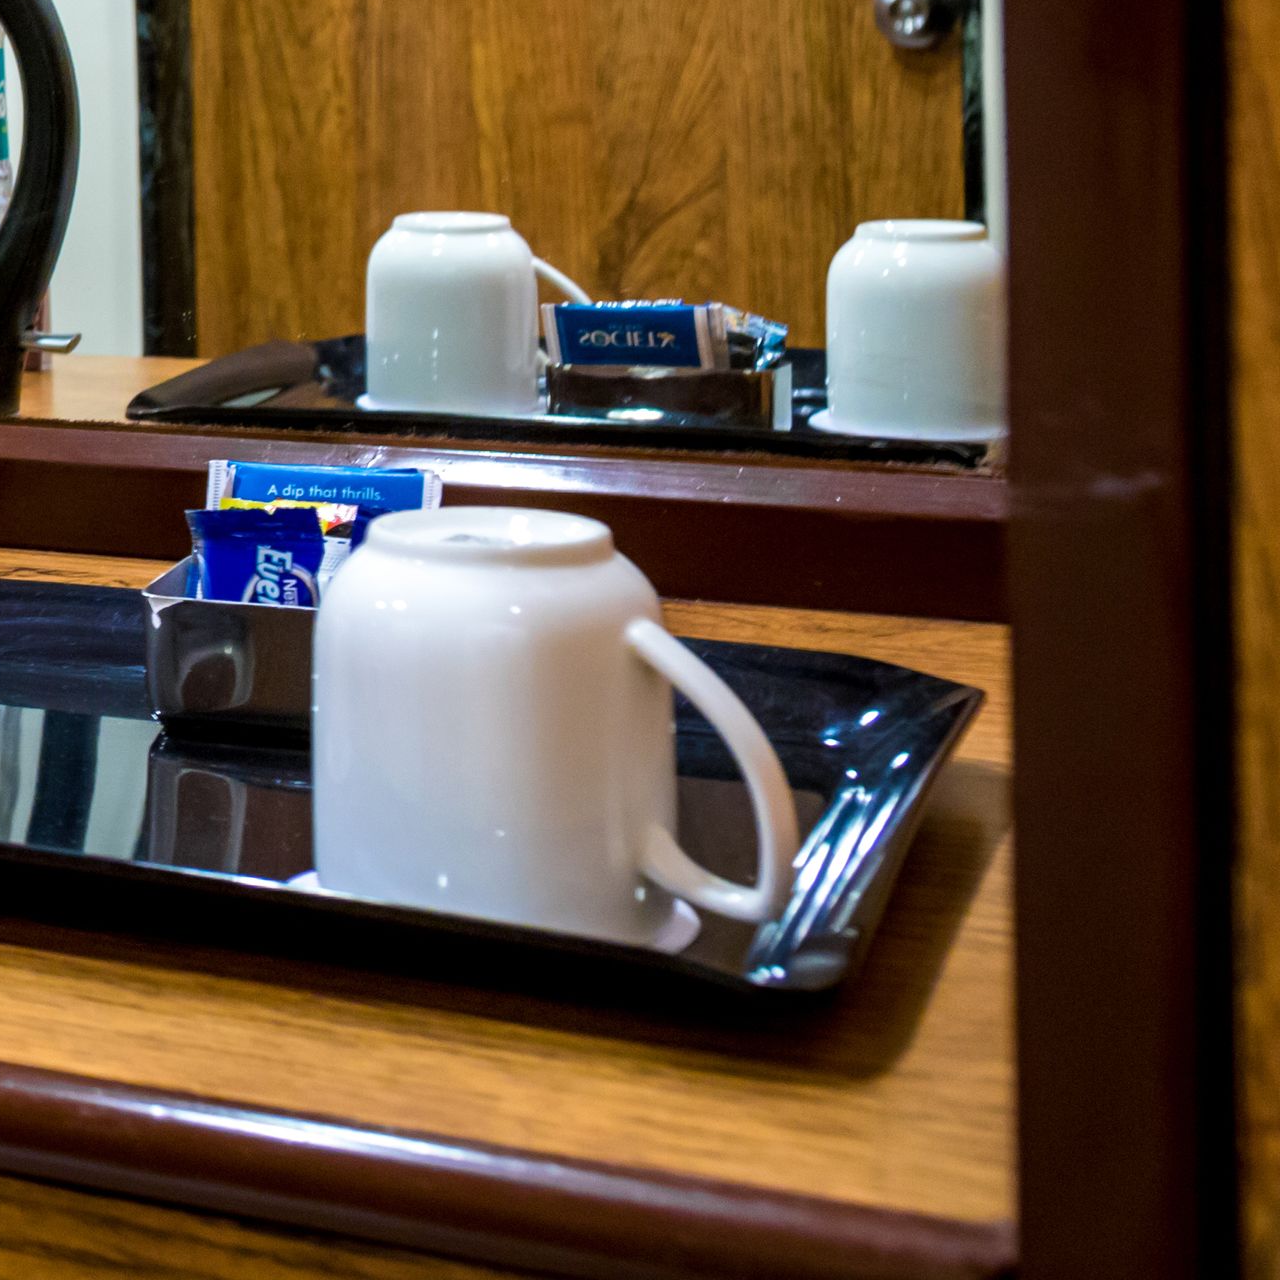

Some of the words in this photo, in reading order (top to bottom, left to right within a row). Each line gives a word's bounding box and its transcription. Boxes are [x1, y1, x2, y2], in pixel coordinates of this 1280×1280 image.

[267, 484, 278, 496] A
[282, 484, 304, 500] dip
[309, 486, 337, 499] that
[342, 487, 385, 501] thrills.
